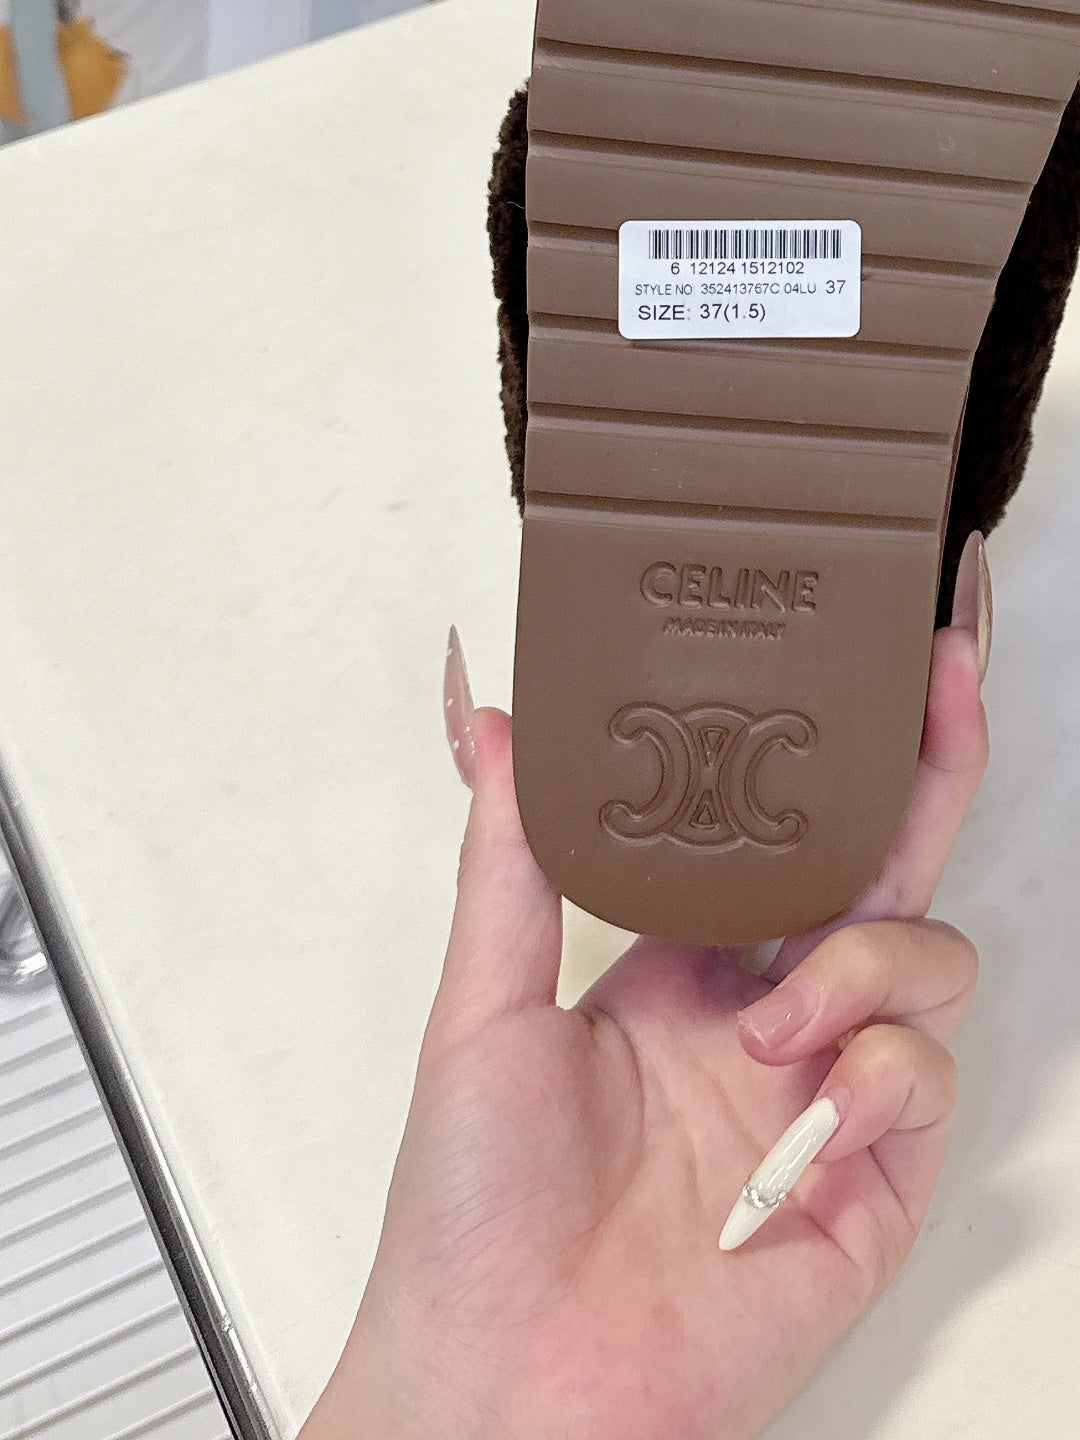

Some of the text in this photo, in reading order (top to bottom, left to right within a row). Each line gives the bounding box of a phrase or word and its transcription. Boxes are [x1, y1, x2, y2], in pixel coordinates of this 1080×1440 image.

[671, 261, 805, 275] 6 12124 1512102
[635, 284, 672, 295] STYLE
[825, 280, 846, 294] 37
[638, 303, 766, 322] SIZE: 37(1.5)
[640, 561, 819, 612] CELINE
